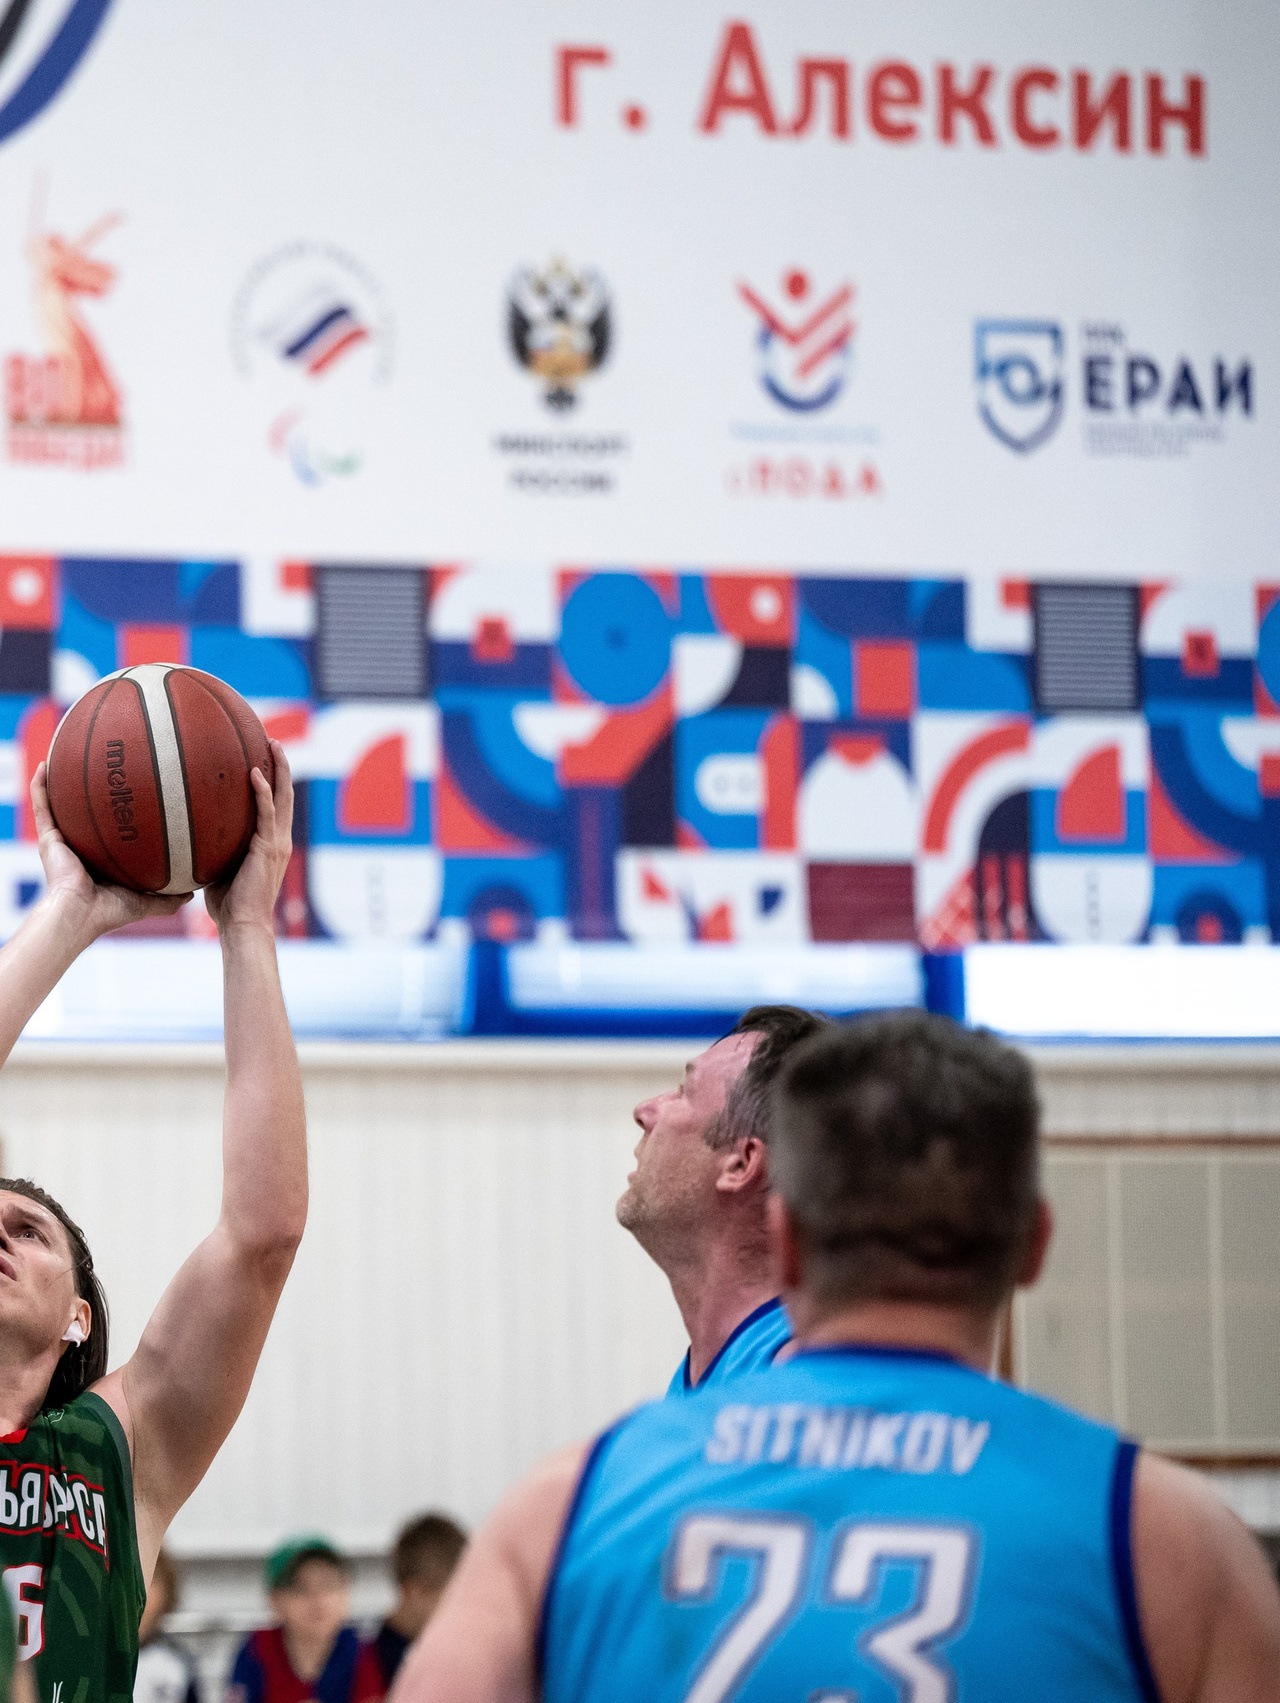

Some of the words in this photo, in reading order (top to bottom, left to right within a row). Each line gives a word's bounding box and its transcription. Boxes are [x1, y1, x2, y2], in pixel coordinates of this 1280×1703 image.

[554, 44, 646, 131] г.
[698, 18, 1208, 160] Алексин
[106, 739, 138, 842] molten
[704, 1404, 991, 1476] SITNIKOV
[2, 1563, 45, 1662] 6
